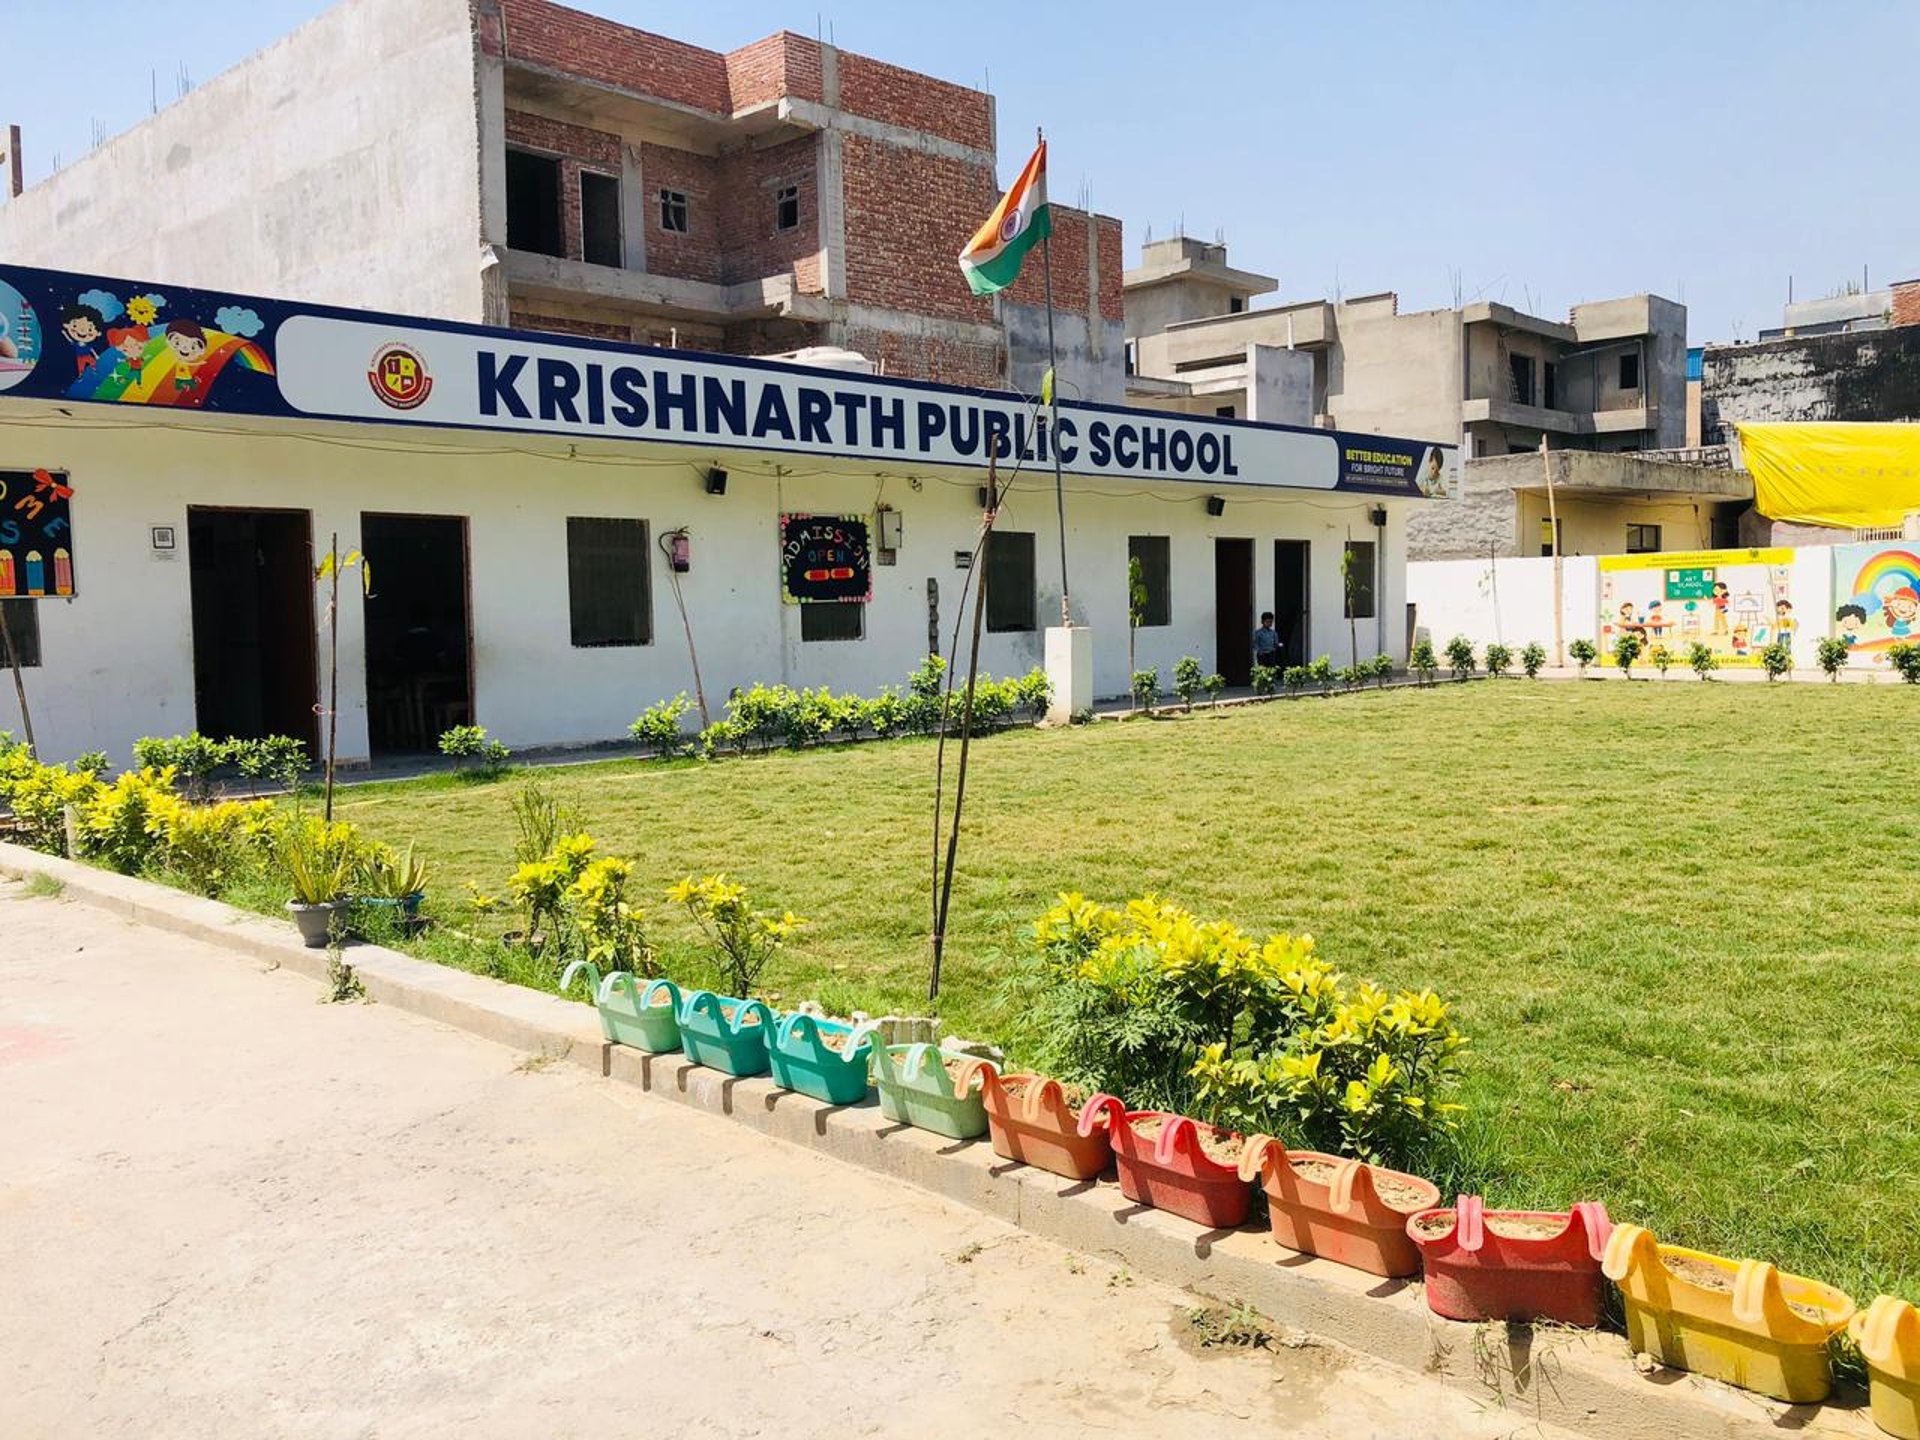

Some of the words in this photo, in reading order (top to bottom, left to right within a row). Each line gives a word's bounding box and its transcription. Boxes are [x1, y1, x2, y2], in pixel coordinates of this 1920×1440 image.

[478, 351, 905, 449] KRISHNARTH
[918, 402, 1079, 464] PUBLIC
[1089, 421, 1238, 476] SCHOOL
[1346, 449, 1371, 463] BETTER
[1373, 452, 1412, 466] EDUCATION
[1351, 463, 1362, 473] FOR
[783, 526, 869, 570] ADMISSION
[808, 550, 845, 562] OPEN
